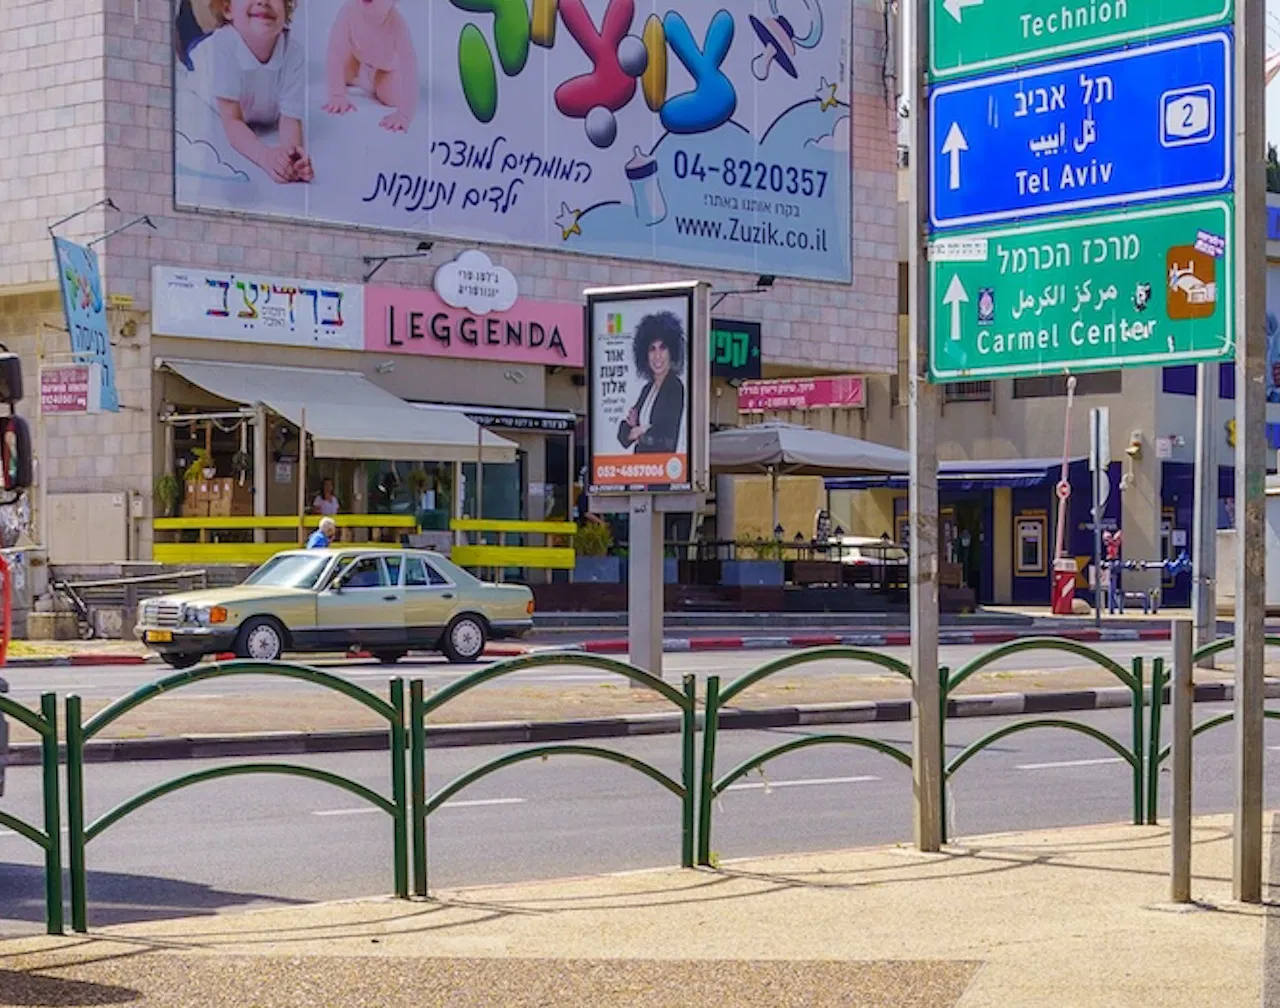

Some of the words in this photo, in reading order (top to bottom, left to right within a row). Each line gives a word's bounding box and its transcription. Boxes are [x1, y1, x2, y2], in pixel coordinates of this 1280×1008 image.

[1021, 0, 1128, 38] Technion
[1013, 83, 1066, 118] אביב
[1080, 73, 1114, 105] תל
[1182, 103, 1194, 127] 2
[1072, 119, 1096, 153] تل
[430, 136, 506, 174] למוצרי
[500, 149, 593, 185] המומחים
[673, 150, 829, 198] 04-8220357
[1016, 170, 1050, 195] Tel
[1060, 159, 1113, 189] Aviv
[362, 172, 457, 213] ותינוקות
[463, 178, 523, 213] ילדים
[740, 199, 773, 215] אותנו
[774, 203, 801, 218] בקרו
[675, 214, 829, 253] www.Zuzik.co.il
[1081, 234, 1140, 265] מרכז
[997, 242, 1070, 275] הכרמל
[1012, 284, 1065, 320] الكرمل
[1072, 279, 1118, 313] مركز
[387, 304, 568, 358] LEGGENDA
[977, 323, 1059, 354] Carmel
[1071, 317, 1158, 346] Center
[601, 378, 627, 397] אלון
